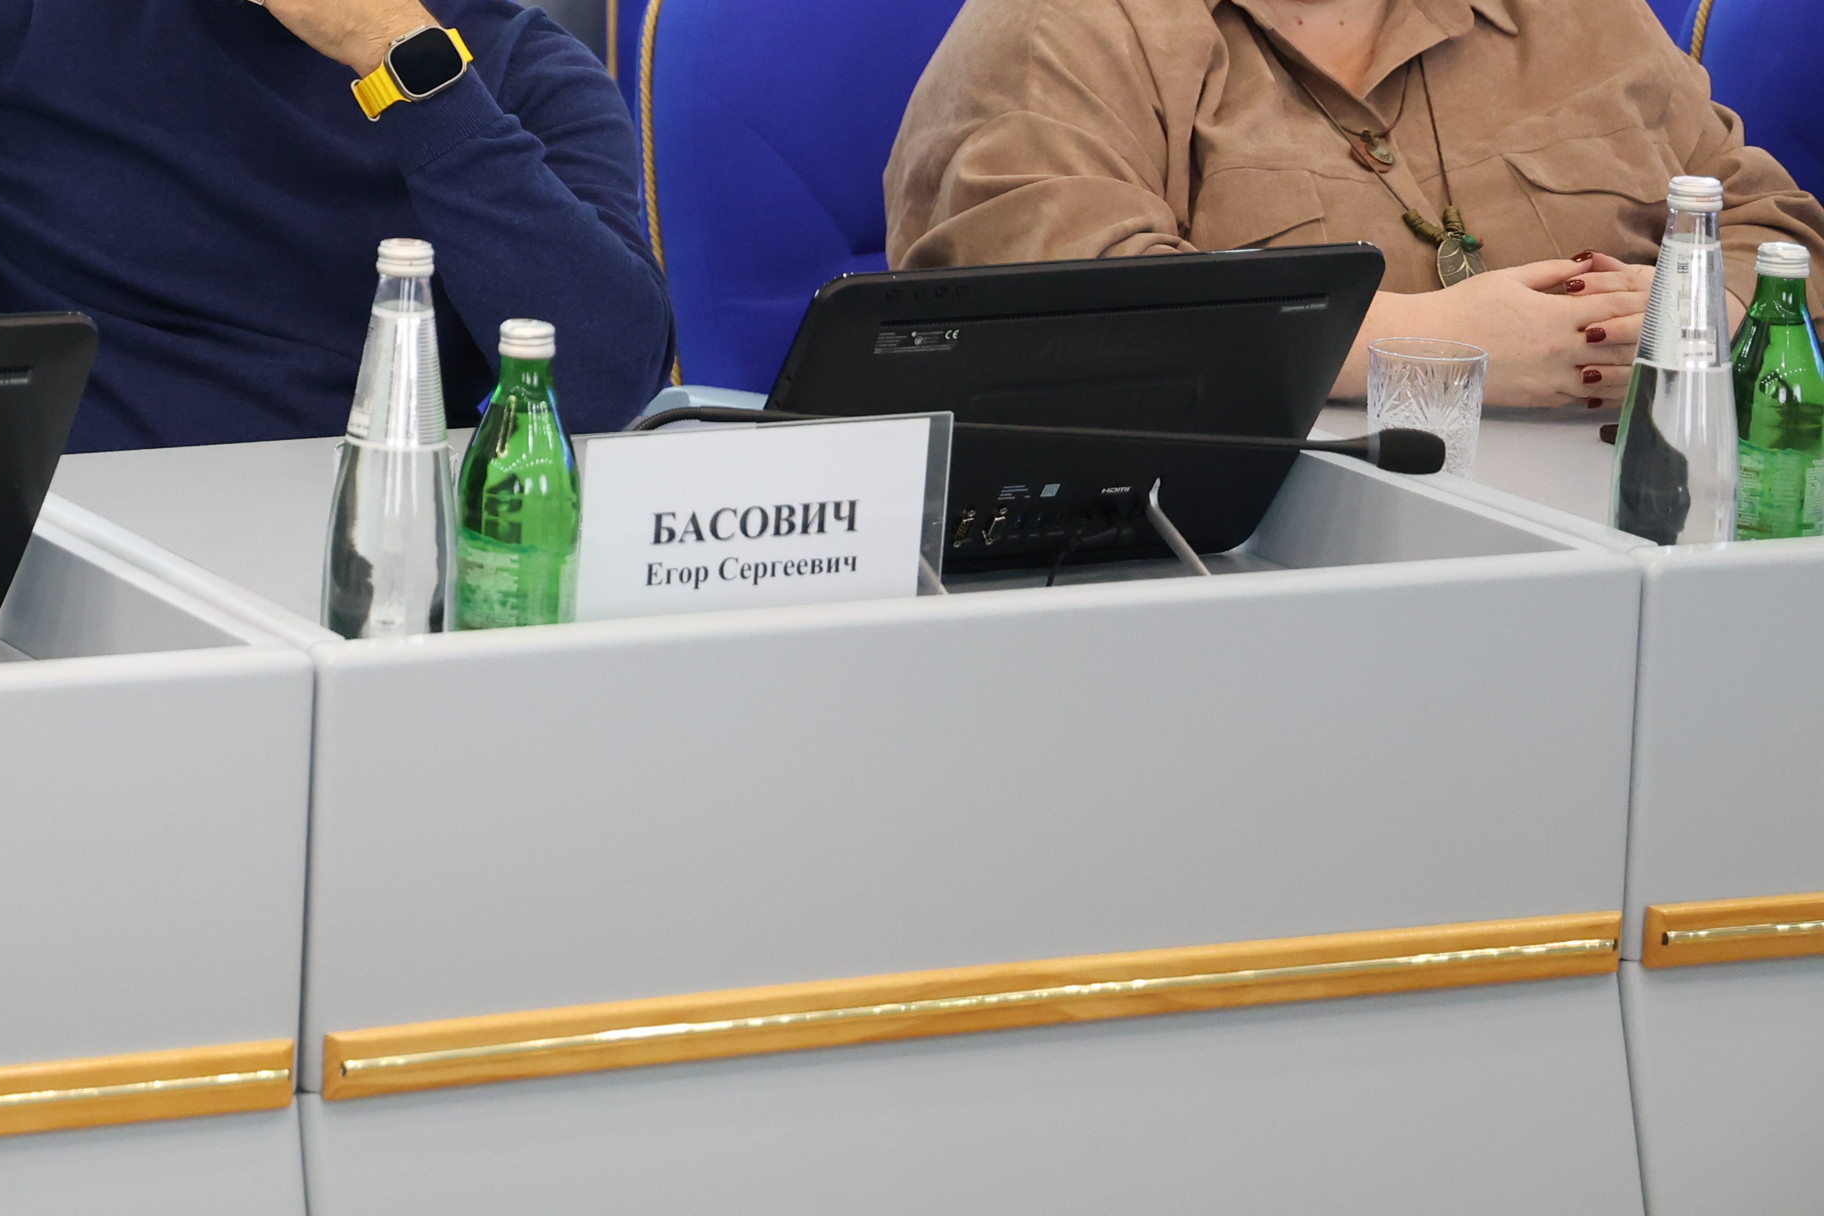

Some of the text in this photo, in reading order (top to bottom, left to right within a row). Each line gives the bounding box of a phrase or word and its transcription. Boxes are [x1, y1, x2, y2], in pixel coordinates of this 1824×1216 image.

[651, 498, 859, 546] БАСОВИЧ
[645, 555, 858, 590] Егор Сергеевич
